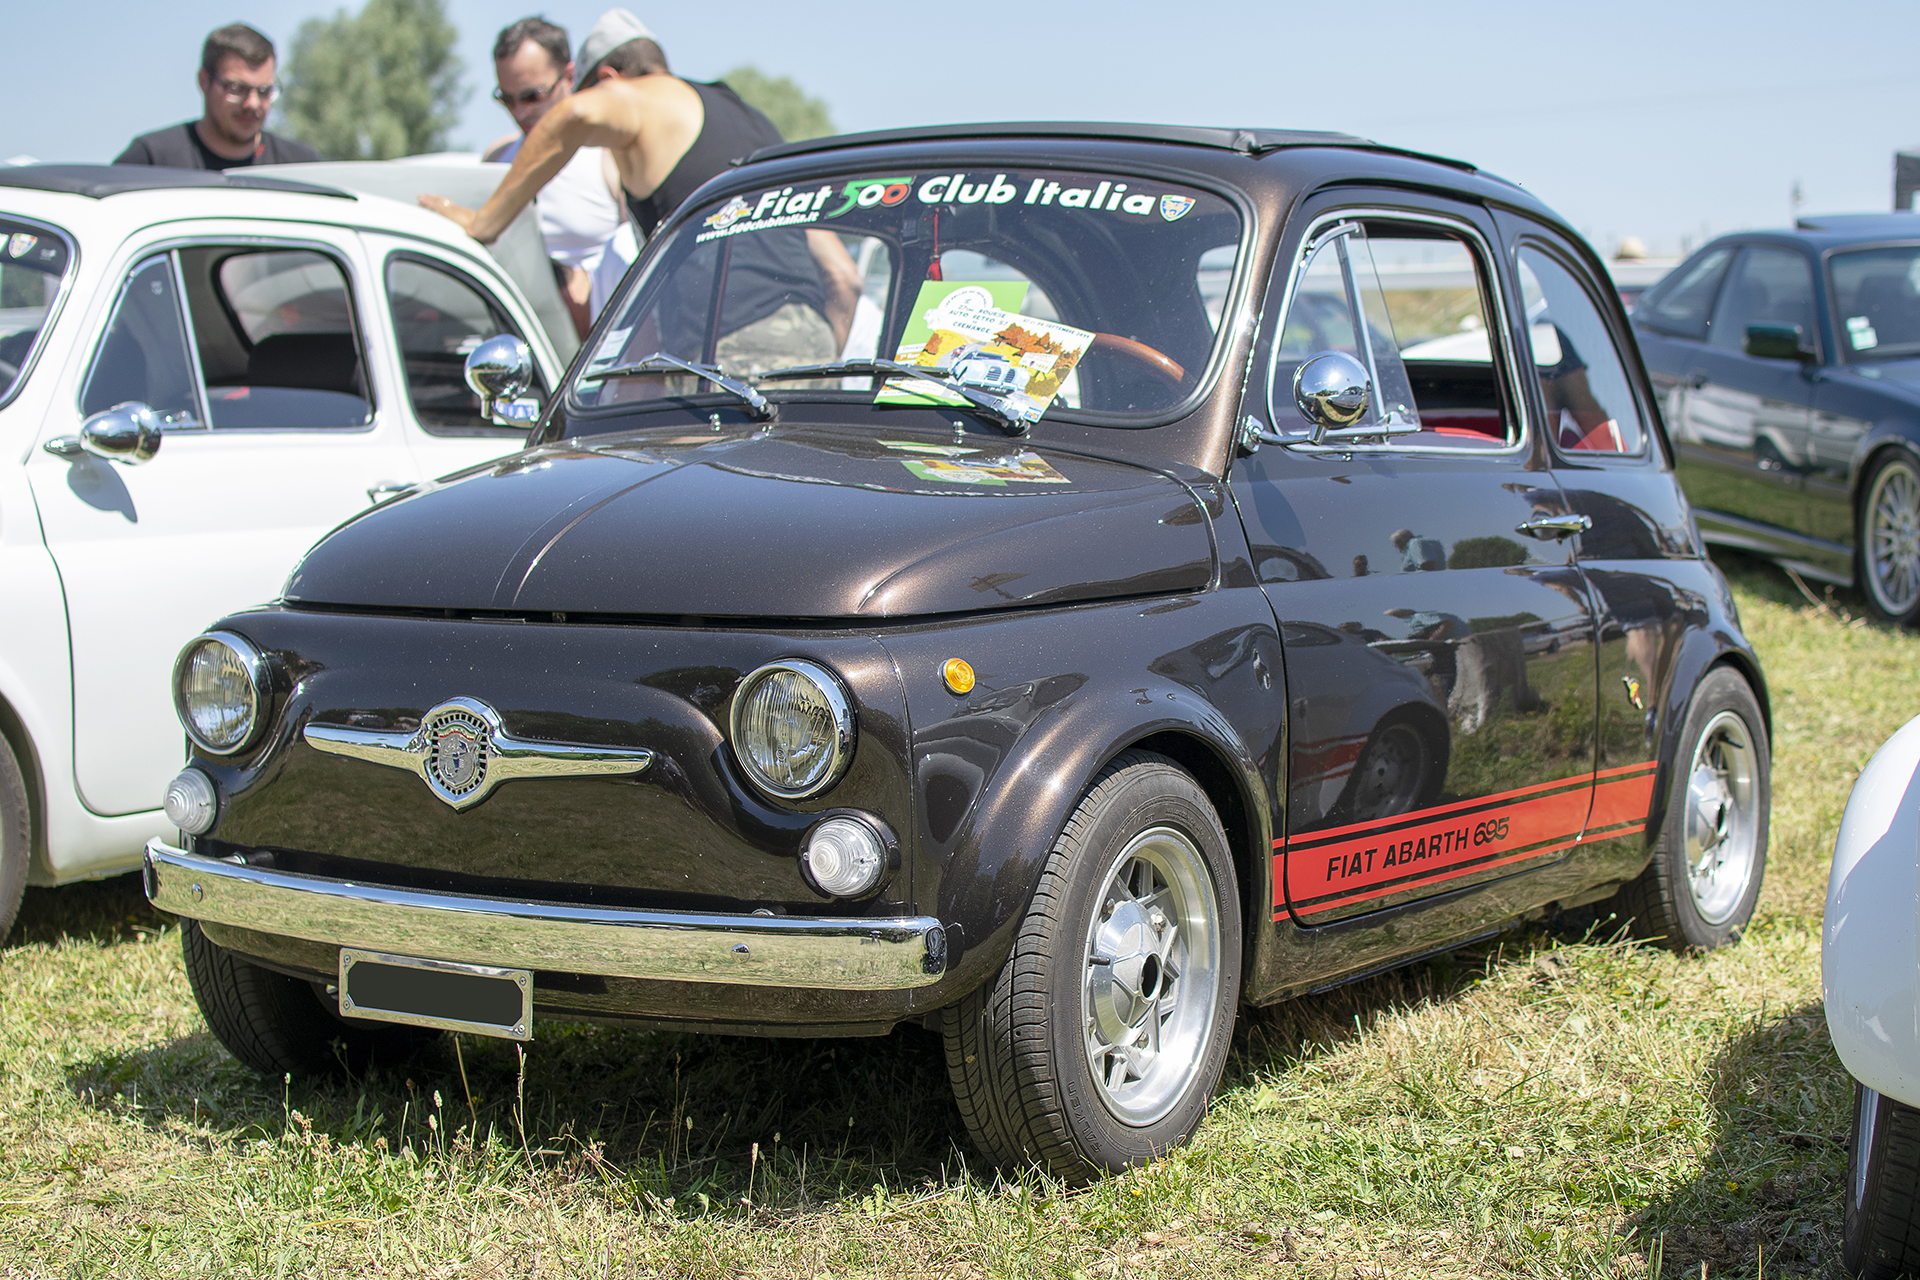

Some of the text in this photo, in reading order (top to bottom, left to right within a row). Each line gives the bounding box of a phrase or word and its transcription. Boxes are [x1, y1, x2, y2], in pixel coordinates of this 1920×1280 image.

[751, 173, 1157, 220] Fiat 500 Club Italia
[948, 309, 969, 318] AUTO
[972, 314, 996, 323] RETRO
[1326, 816, 1510, 882] FIAT ABARTH 695
[1067, 1079, 1102, 1152] FALKEN
